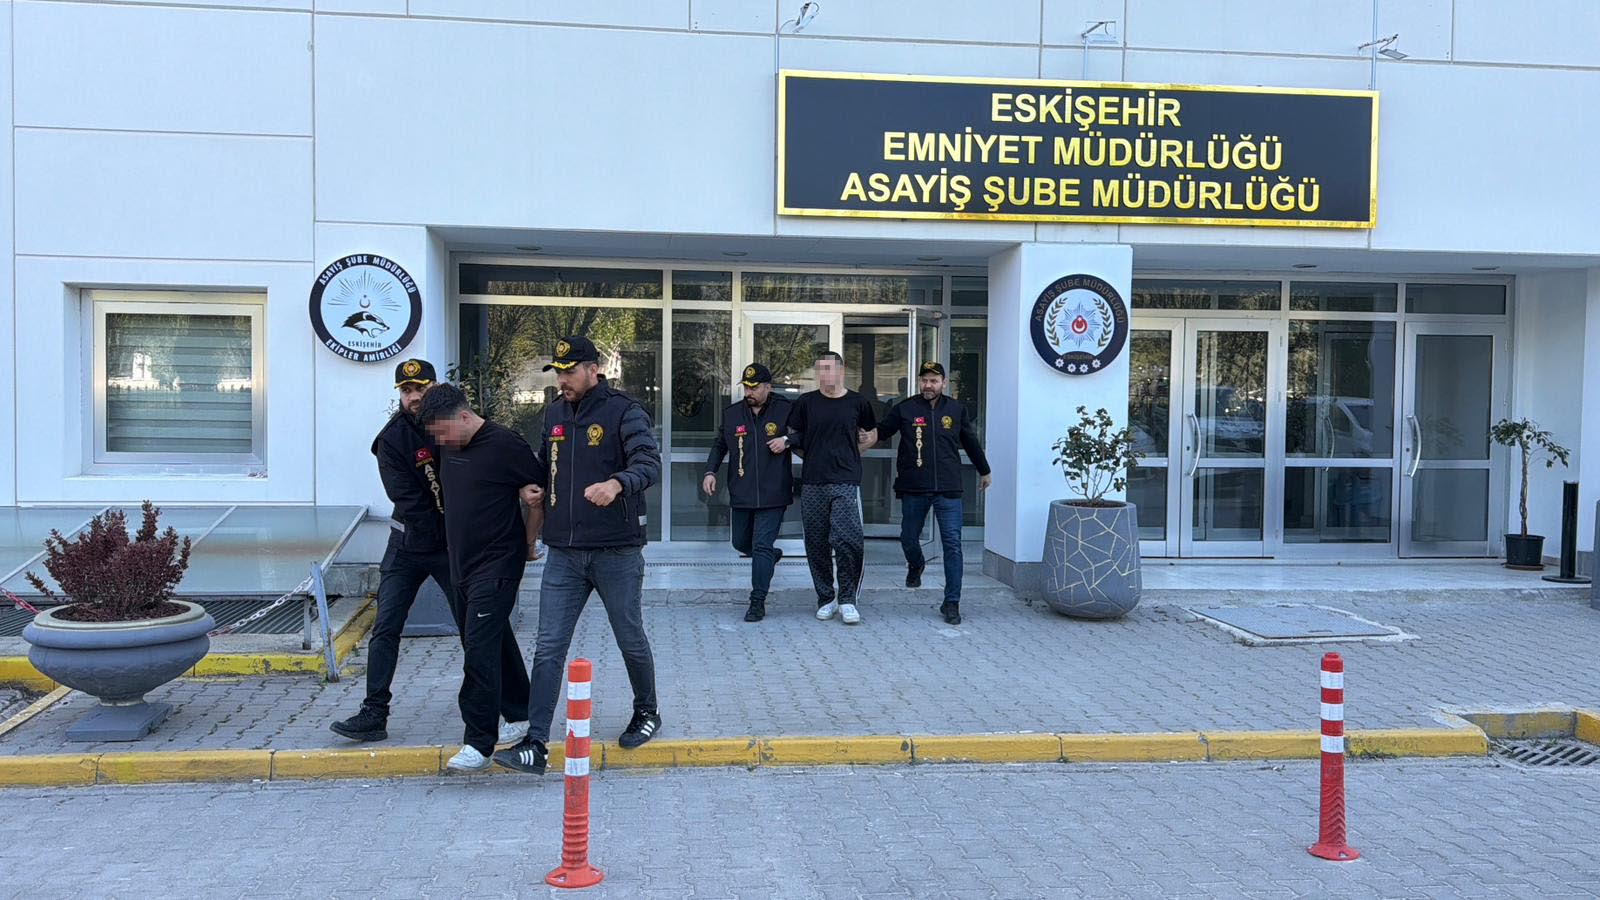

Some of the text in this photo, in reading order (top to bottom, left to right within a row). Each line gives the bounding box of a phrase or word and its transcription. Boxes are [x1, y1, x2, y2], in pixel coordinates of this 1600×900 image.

[990, 87, 1181, 131] ESKİŞEHİR
[883, 126, 1283, 170] EMNİYET MÜDÜRLÜĞÜ
[840, 167, 1321, 213] ASAYİŞ ŞUBE MÜDÜRLÜĞÜ
[319, 255, 416, 293] ASAYİŞ ŞUBE MÜDÜRLÜĞÜ
[325, 338, 402, 362] EKİPLER AMİRLİĞİ
